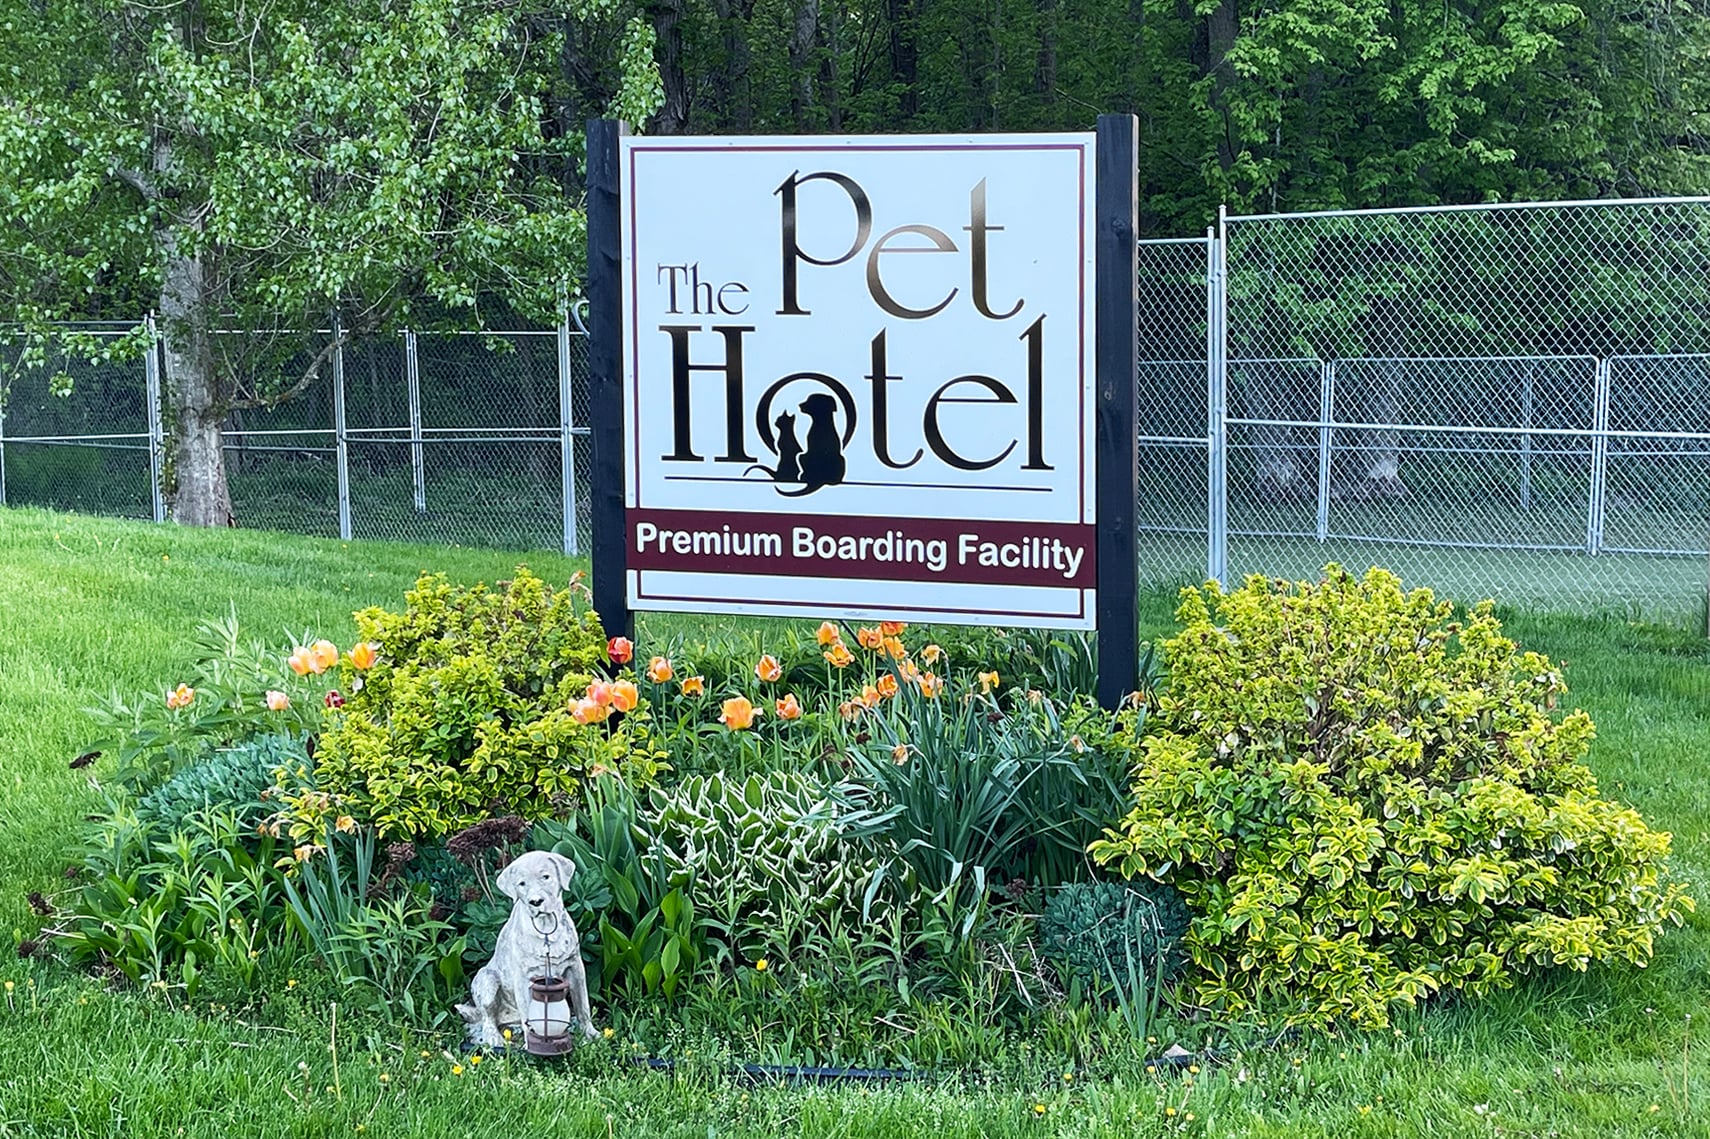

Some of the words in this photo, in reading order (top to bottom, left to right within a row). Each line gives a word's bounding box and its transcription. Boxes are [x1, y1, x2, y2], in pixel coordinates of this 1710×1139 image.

[657, 262, 750, 316] The
[773, 169, 1024, 320] Pet
[658, 313, 1055, 471] Hotel
[635, 522, 783, 557] Premium
[791, 526, 948, 572] Boarding
[957, 534, 1085, 578] Facility
